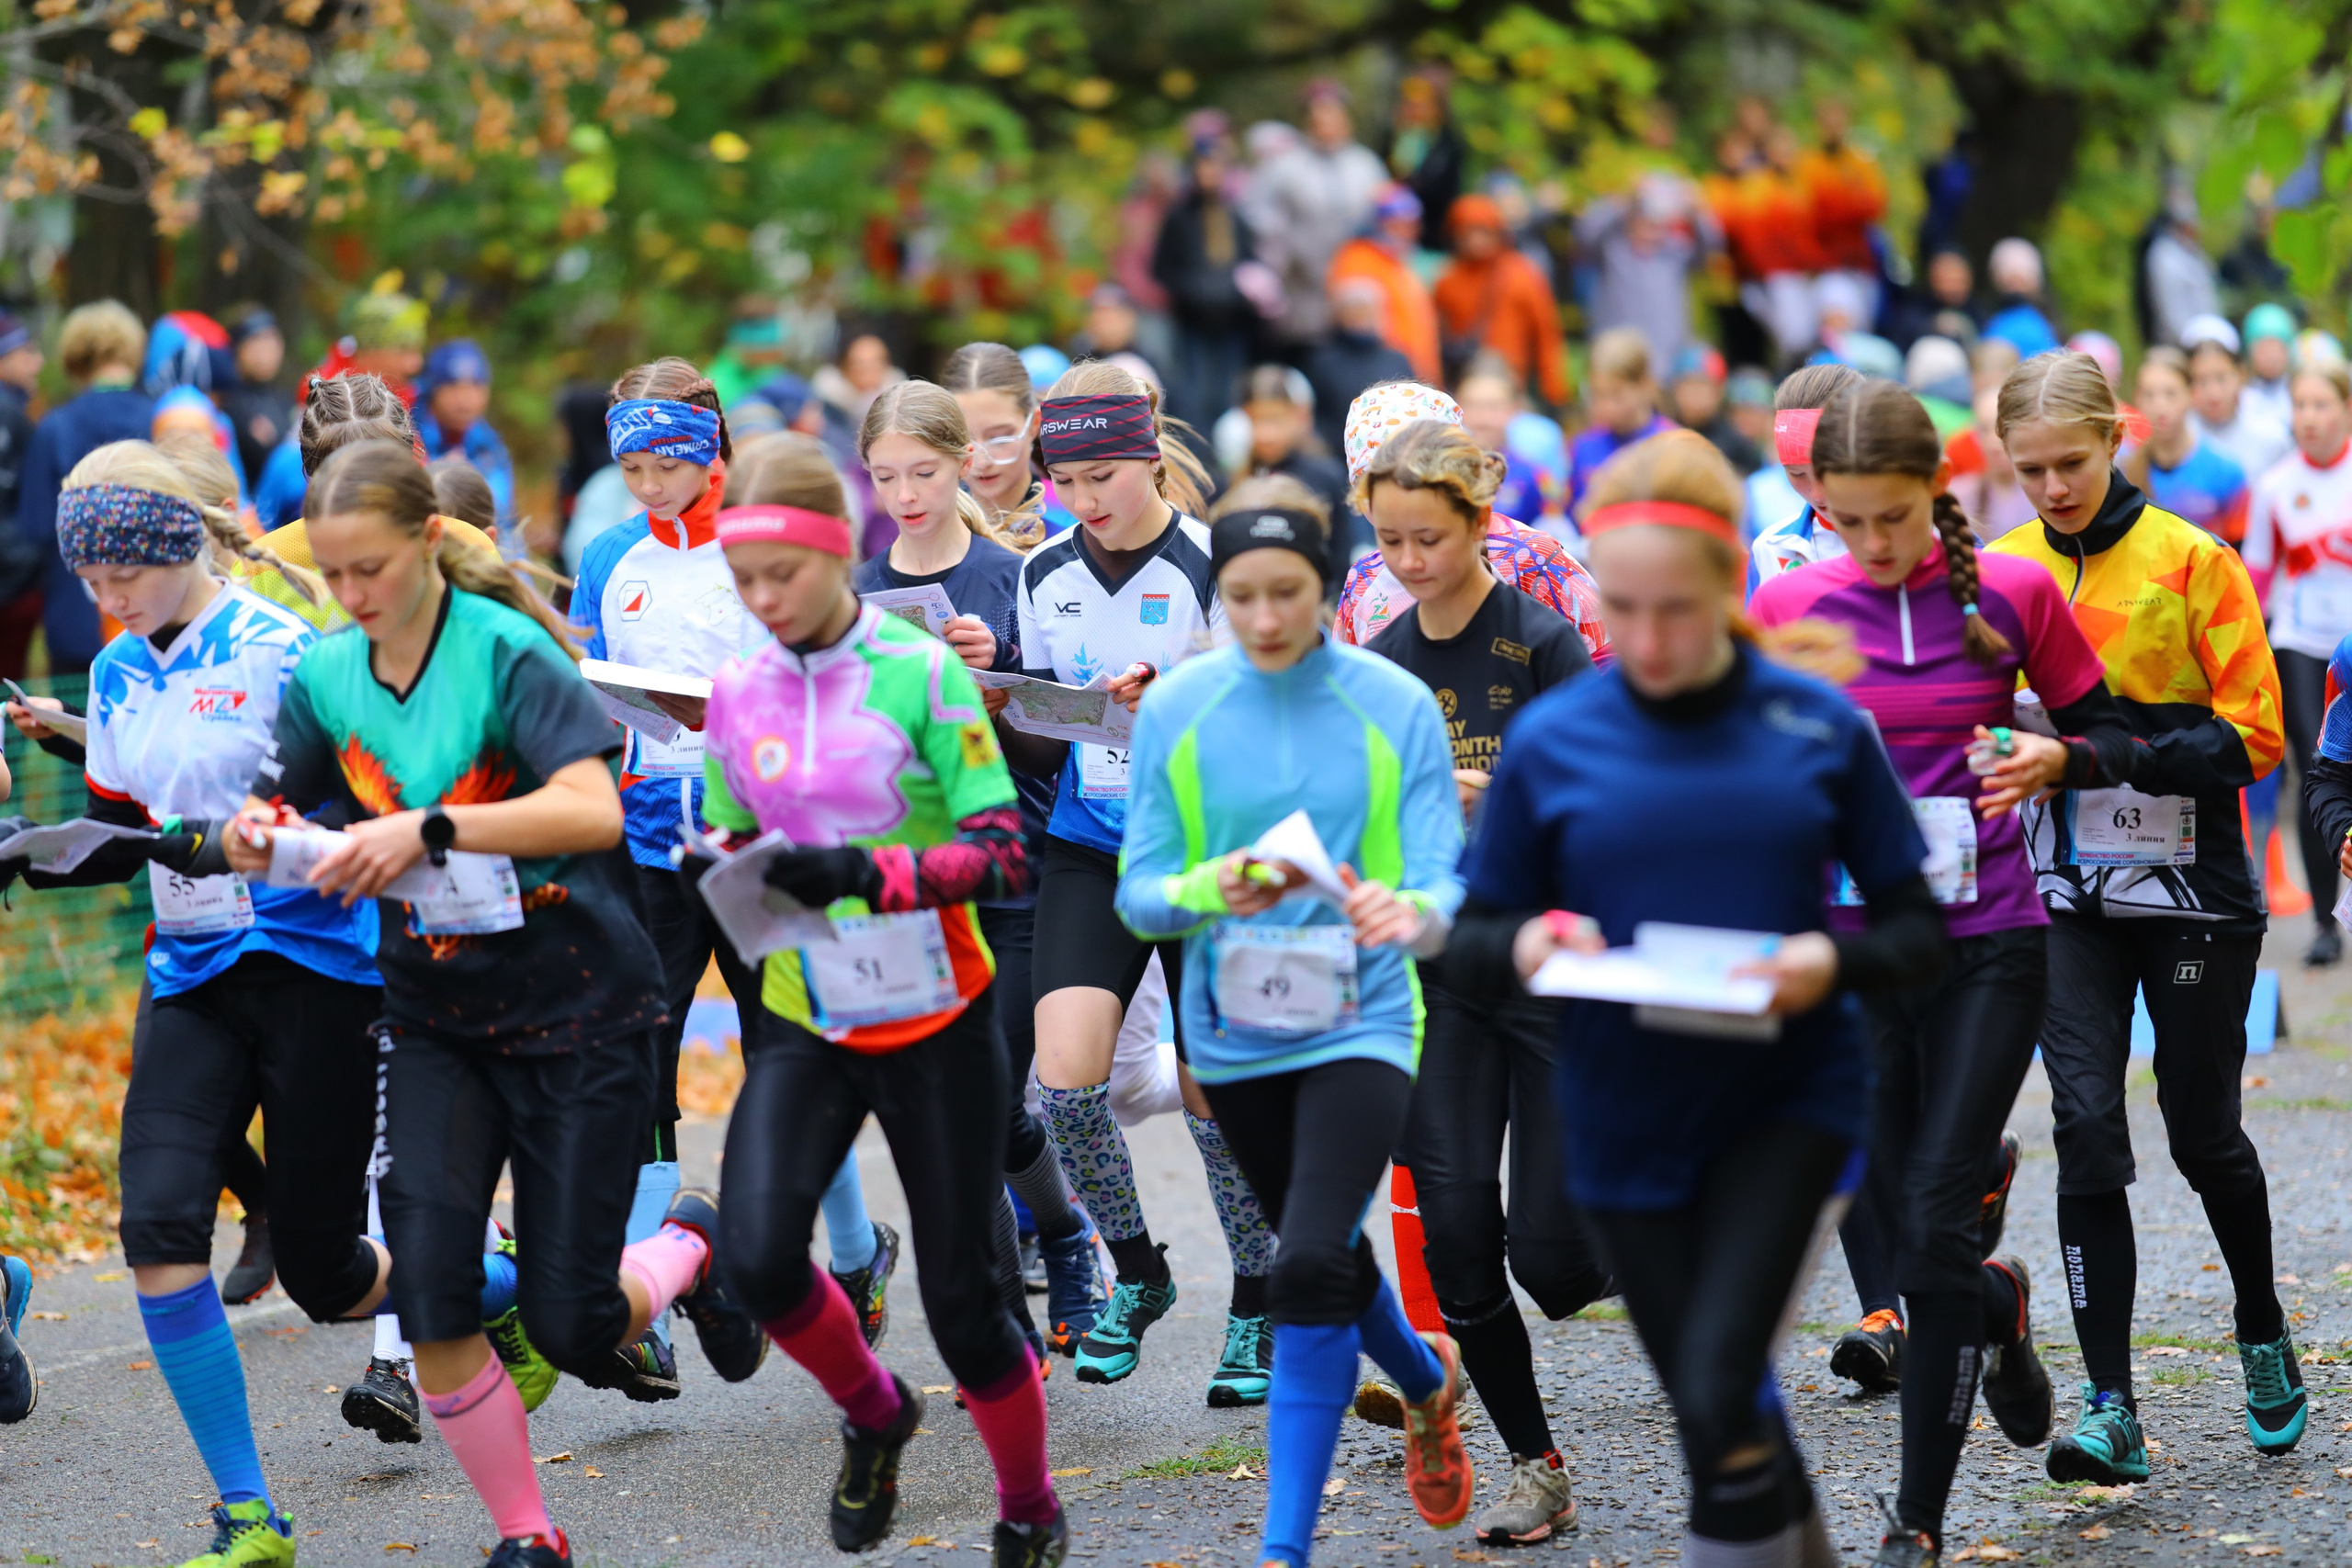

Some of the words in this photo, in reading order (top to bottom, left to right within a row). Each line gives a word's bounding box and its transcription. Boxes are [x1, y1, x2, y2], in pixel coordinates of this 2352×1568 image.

[653, 439, 709, 457] CRIMEAN
[1445, 719, 1466, 738] AY
[1107, 746, 1131, 764] 52
[1452, 736, 1502, 757] ONTH
[2113, 807, 2142, 829] 63
[2126, 833, 2132, 841] 3
[2133, 835, 2165, 843] линия
[169, 874, 196, 897] 55
[854, 957, 883, 986] 51
[1260, 976, 1291, 998] 49
